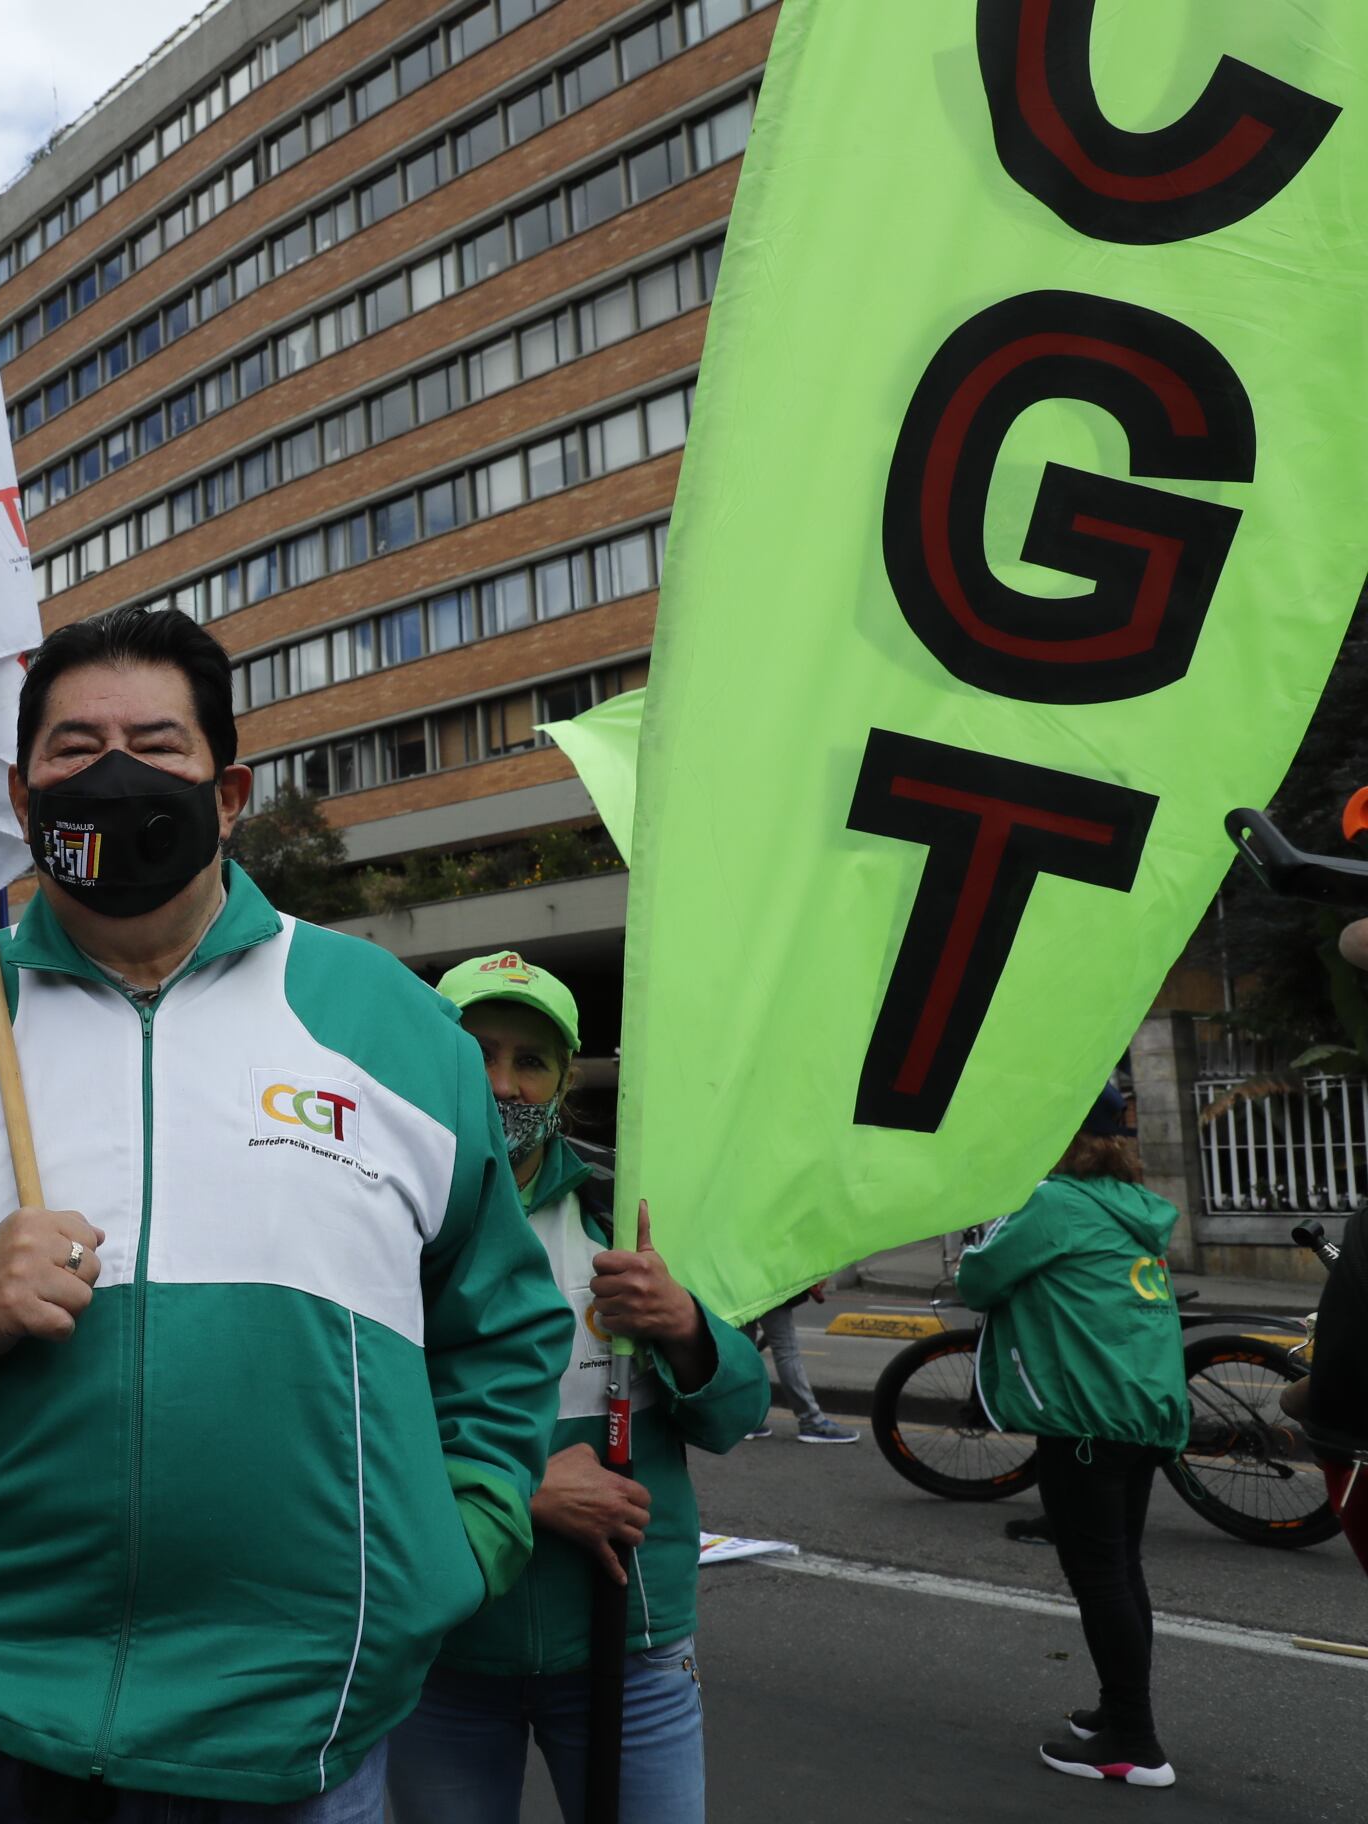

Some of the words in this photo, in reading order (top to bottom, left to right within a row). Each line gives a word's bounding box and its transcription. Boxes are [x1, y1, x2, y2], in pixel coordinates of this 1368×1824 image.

[845, 0, 1343, 1133] CGT
[261, 1083, 357, 1142] CGT
[248, 1136, 310, 1152] Confederación
[311, 1145, 340, 1162] General
[341, 1156, 354, 1167] del
